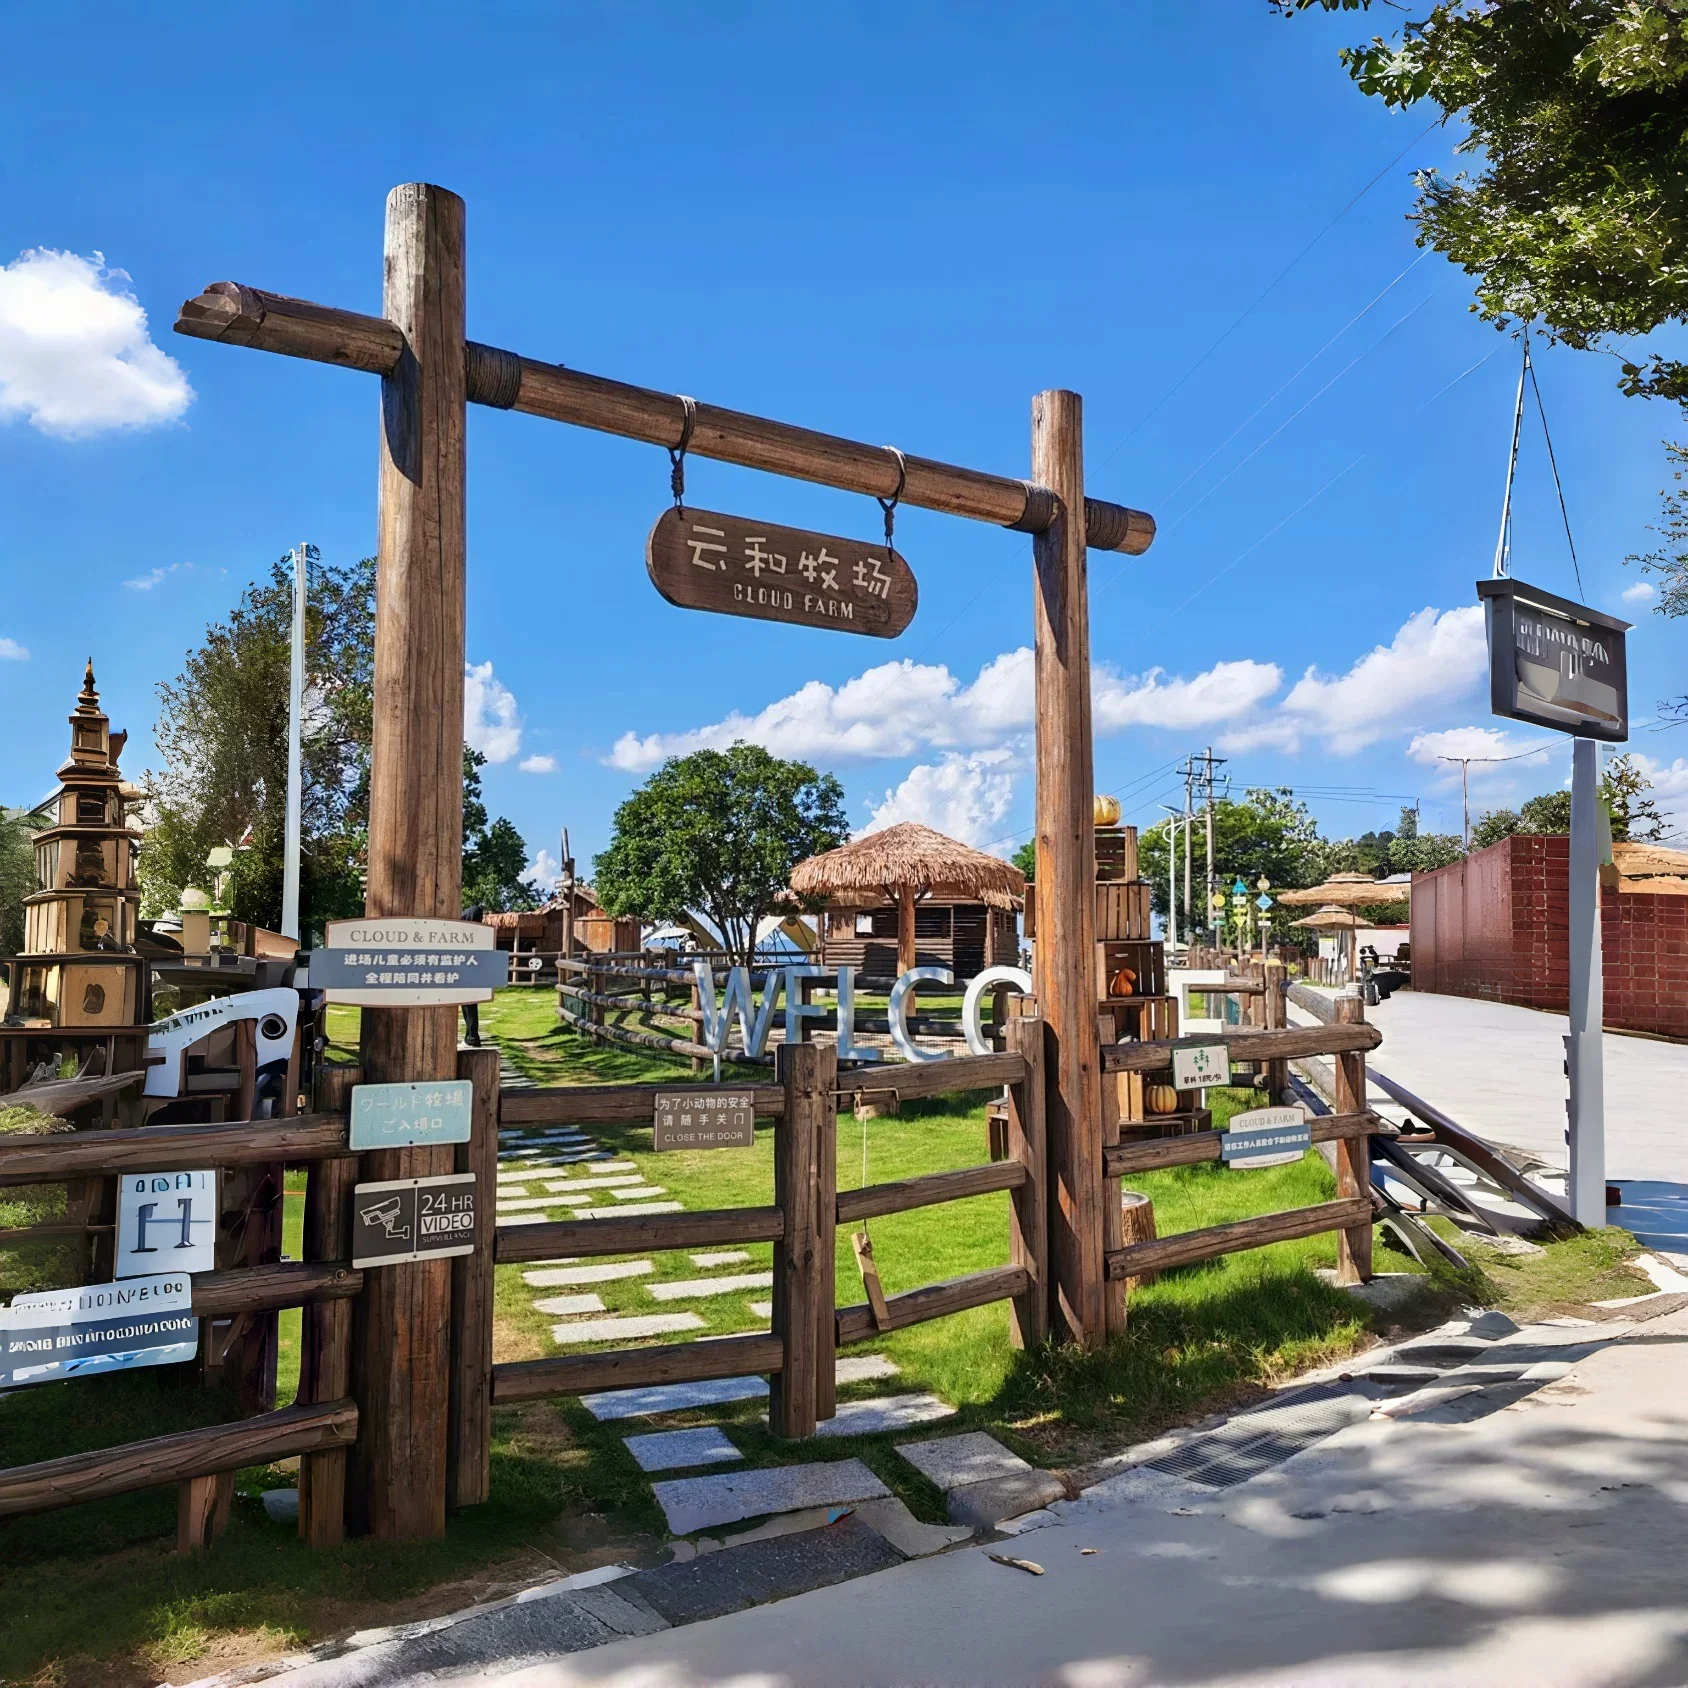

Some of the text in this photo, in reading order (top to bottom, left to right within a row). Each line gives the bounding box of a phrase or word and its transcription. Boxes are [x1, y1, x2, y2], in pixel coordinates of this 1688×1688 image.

[687, 525, 892, 599] 云和牧场
[734, 583, 853, 619] CLOUD FARM
[350, 930, 475, 944] CLOUD & FARM
[344, 954, 478, 966] 进场儿童必须有监护人
[365, 972, 459, 984] 全程陪同并看护
[660, 1097, 749, 1110] 为了小动物的安全
[1239, 1117, 1265, 1128] CLOUD
[1273, 1114, 1295, 1124] FARM
[664, 1132, 744, 1142] CLOSE THE DOOR
[421, 1193, 473, 1215] 24 HR
[422, 1213, 473, 1233] VIDEO
